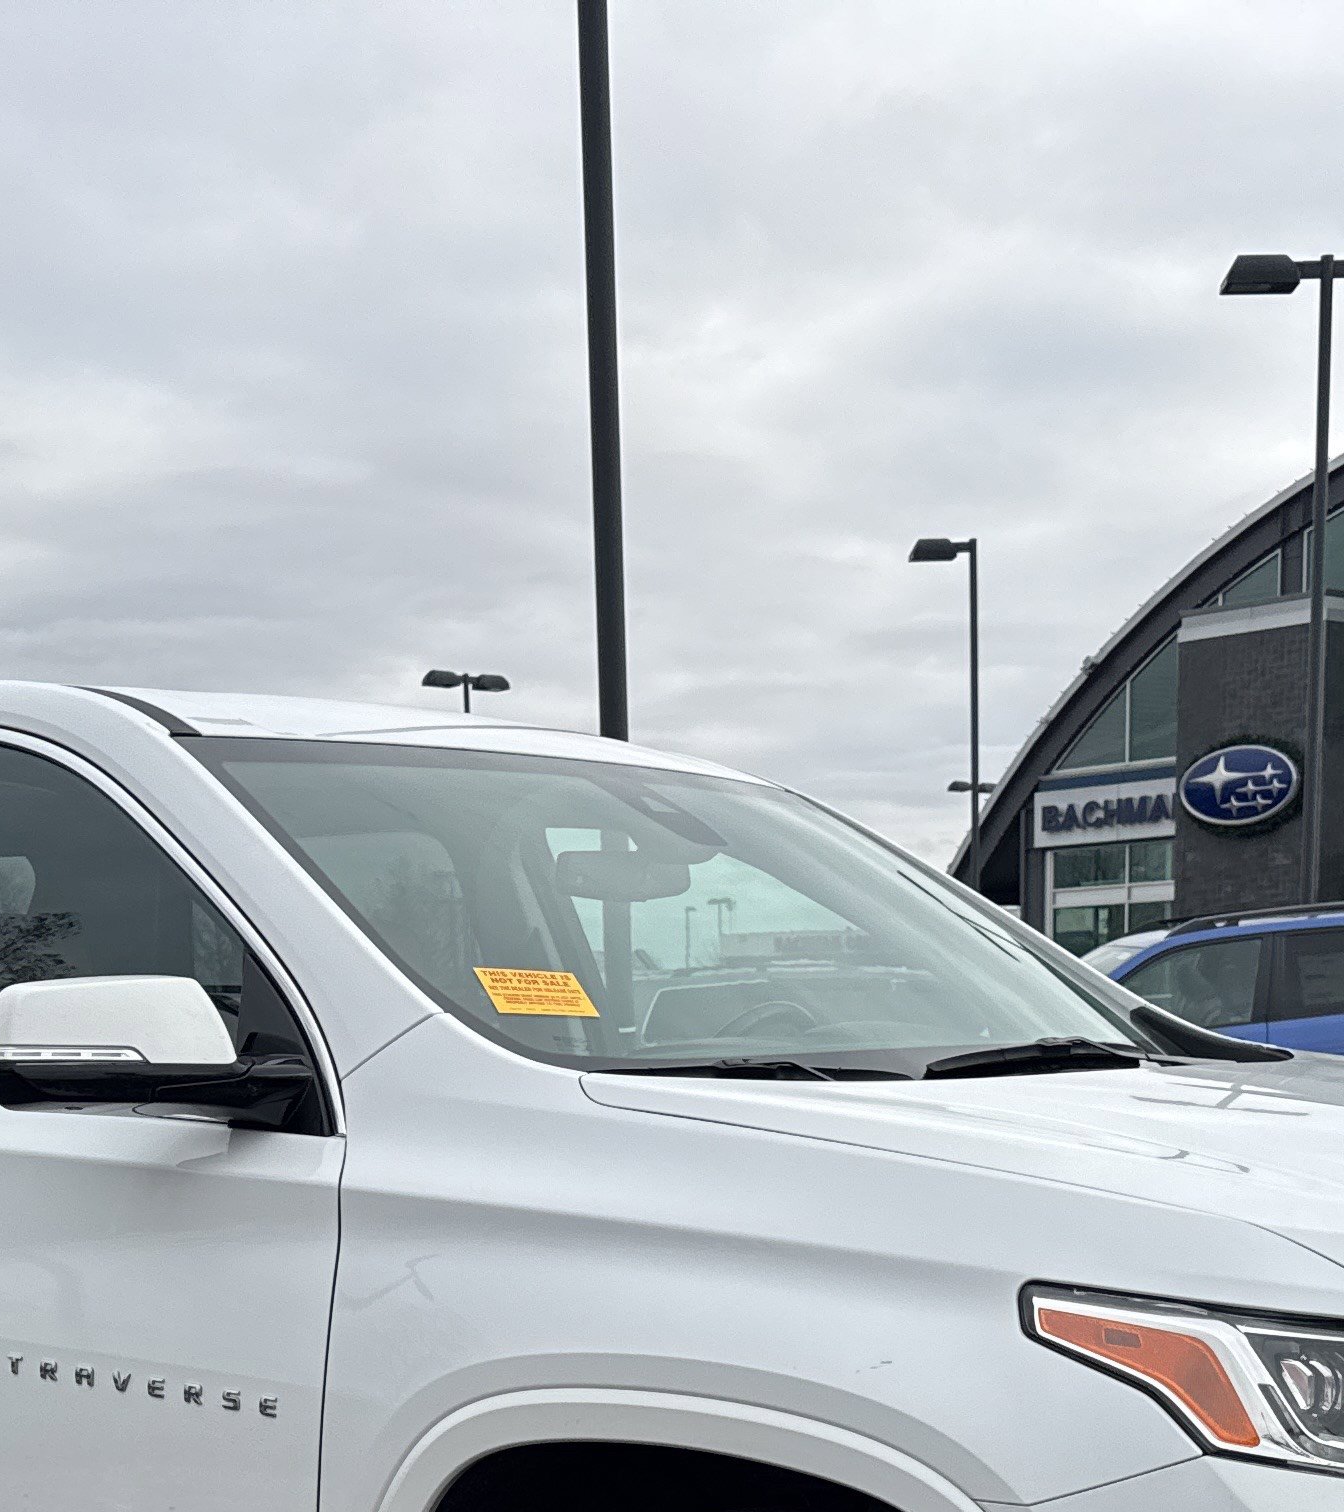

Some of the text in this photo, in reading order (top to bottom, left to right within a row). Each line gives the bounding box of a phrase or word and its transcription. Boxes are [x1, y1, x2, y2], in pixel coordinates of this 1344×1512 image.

[1041, 793, 1177, 833] BACHMA
[480, 970, 572, 981] THIS VEHICLE IS
[490, 977, 571, 988] NOT FOR SALE
[7, 1353, 278, 1419] TRAVERSE
